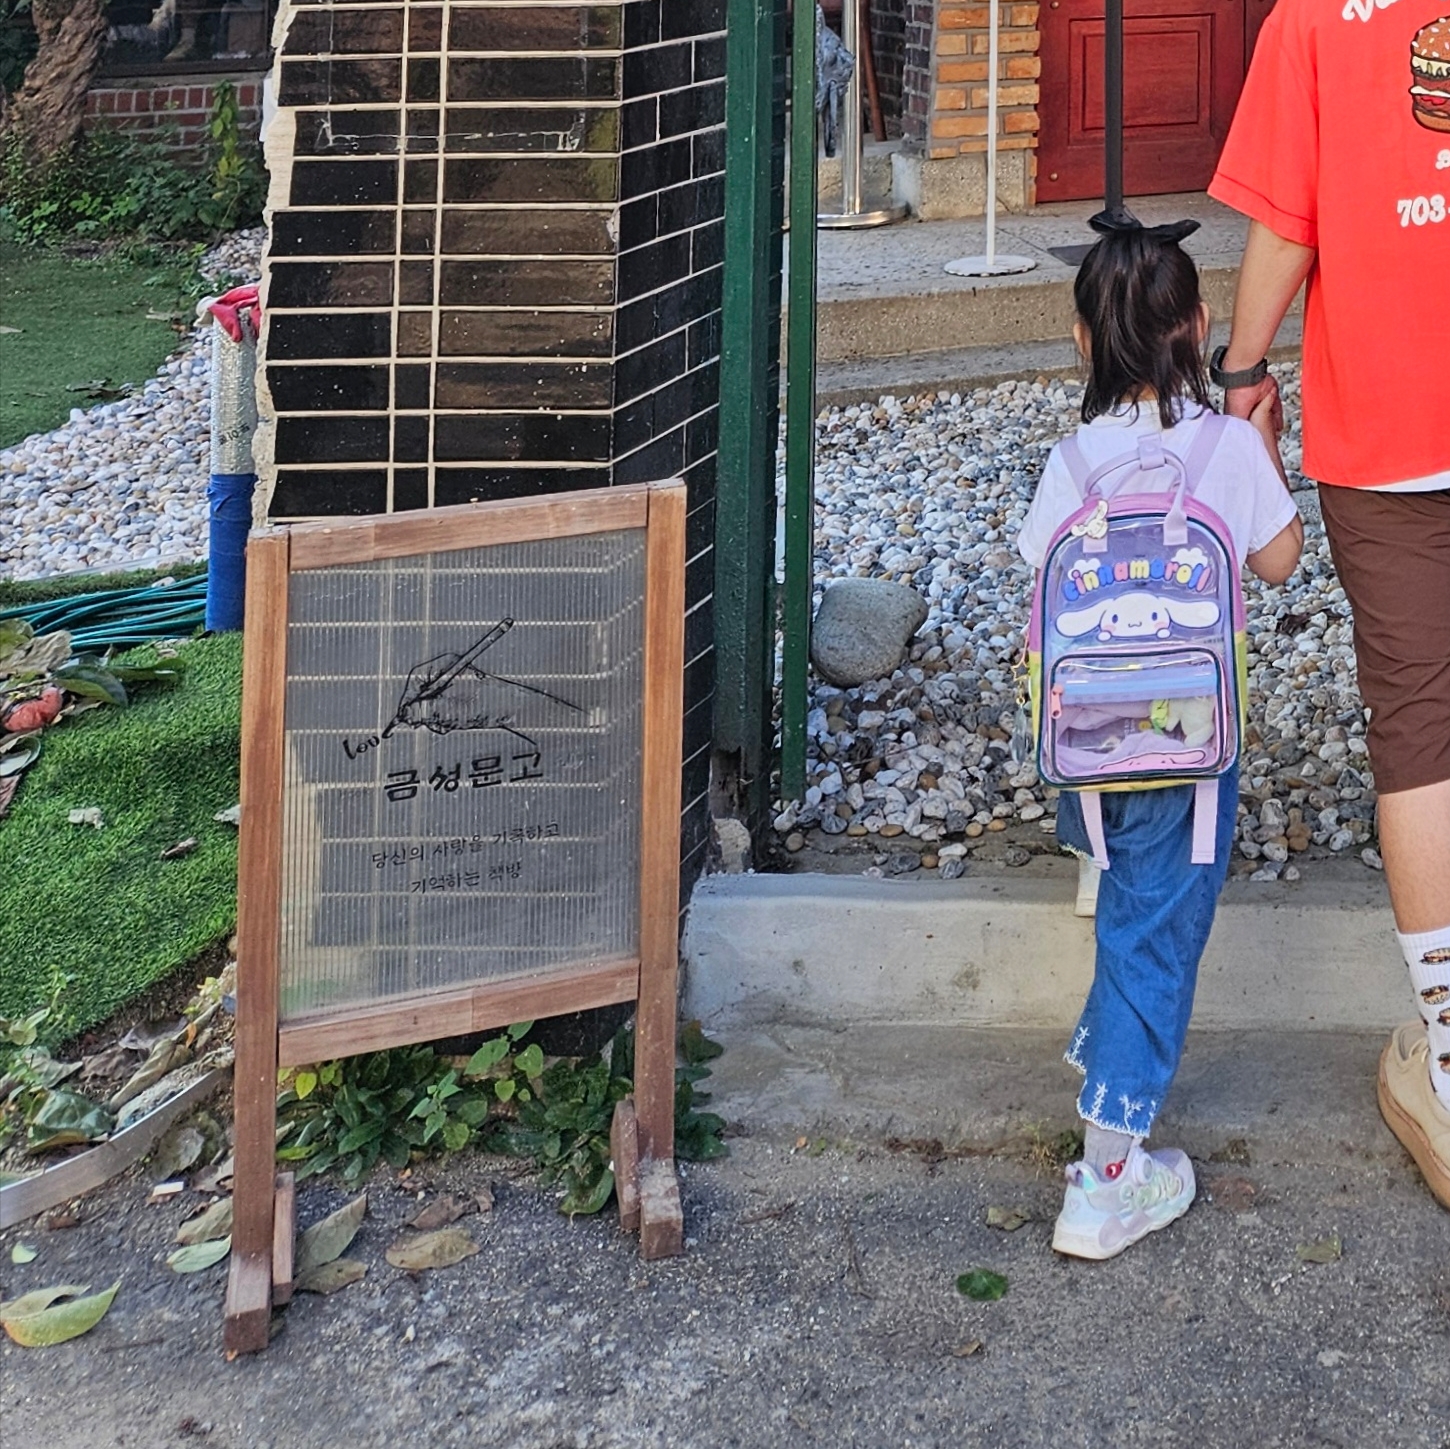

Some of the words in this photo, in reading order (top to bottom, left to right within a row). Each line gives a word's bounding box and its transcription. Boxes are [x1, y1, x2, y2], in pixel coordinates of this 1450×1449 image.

[1063, 558, 1212, 601] cinnamoroll
[384, 751, 543, 802] 금성문고
[372, 844, 425, 869] 당신의
[432, 834, 485, 858] 사랑을
[493, 821, 560, 845] 기록하고
[412, 870, 481, 894] 기억하는
[488, 861, 522, 881] 책방
